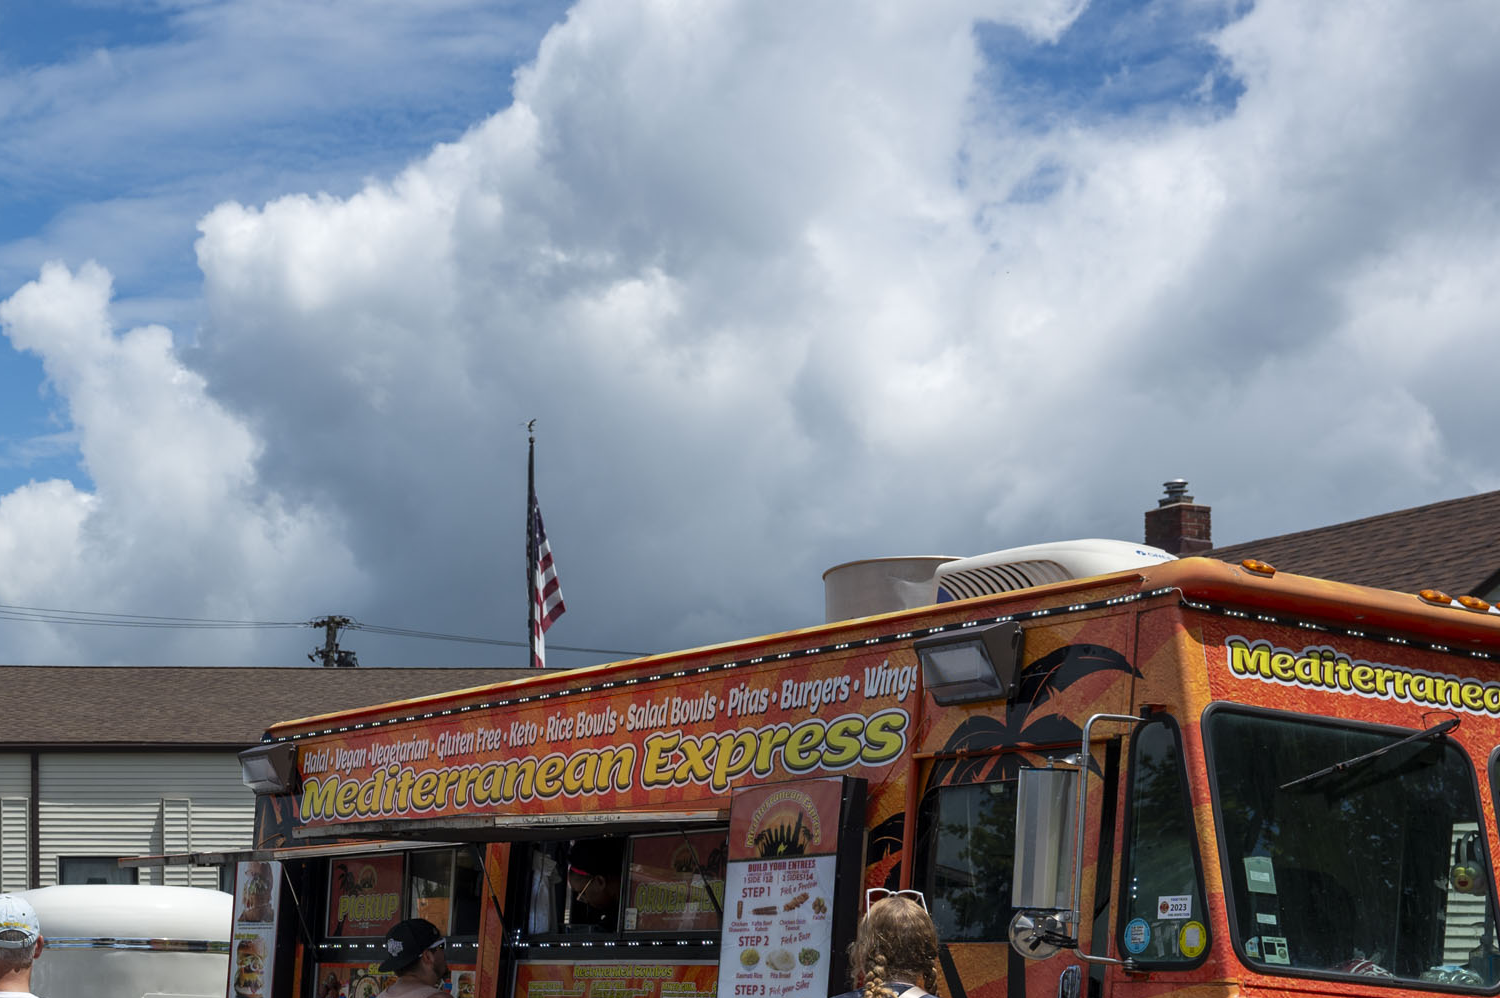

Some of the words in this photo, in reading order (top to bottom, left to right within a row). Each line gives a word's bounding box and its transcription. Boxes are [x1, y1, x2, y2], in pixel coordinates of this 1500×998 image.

[303, 751, 328, 774] Halal
[335, 746, 366, 775] Vegan
[371, 738, 429, 767] Vegetarian
[437, 732, 475, 758] Gluten
[477, 727, 501, 751] Free
[510, 721, 537, 747] Keto
[547, 712, 574, 743] Rice
[576, 706, 617, 739] Bowls
[627, 697, 669, 732] Salad
[671, 691, 716, 726] Bowls
[728, 683, 769, 717] Pitas
[780, 675, 850, 713] Burgers
[301, 746, 636, 823] Mediterranean
[643, 710, 908, 791] Express
[748, 863, 768, 873] BUILD
[770, 861, 786, 871] YOUR
[788, 859, 816, 870] ENTREES
[636, 882, 687, 913] ORDER
[690, 880, 724, 913] HER
[742, 887, 766, 898] STEP
[338, 893, 399, 922] PICKUP
[1170, 904, 1187, 912] 2023
[739, 936, 762, 947] STEP
[763, 936, 769, 946] 2
[735, 985, 758, 996] STEP
[760, 985, 765, 996] 3
